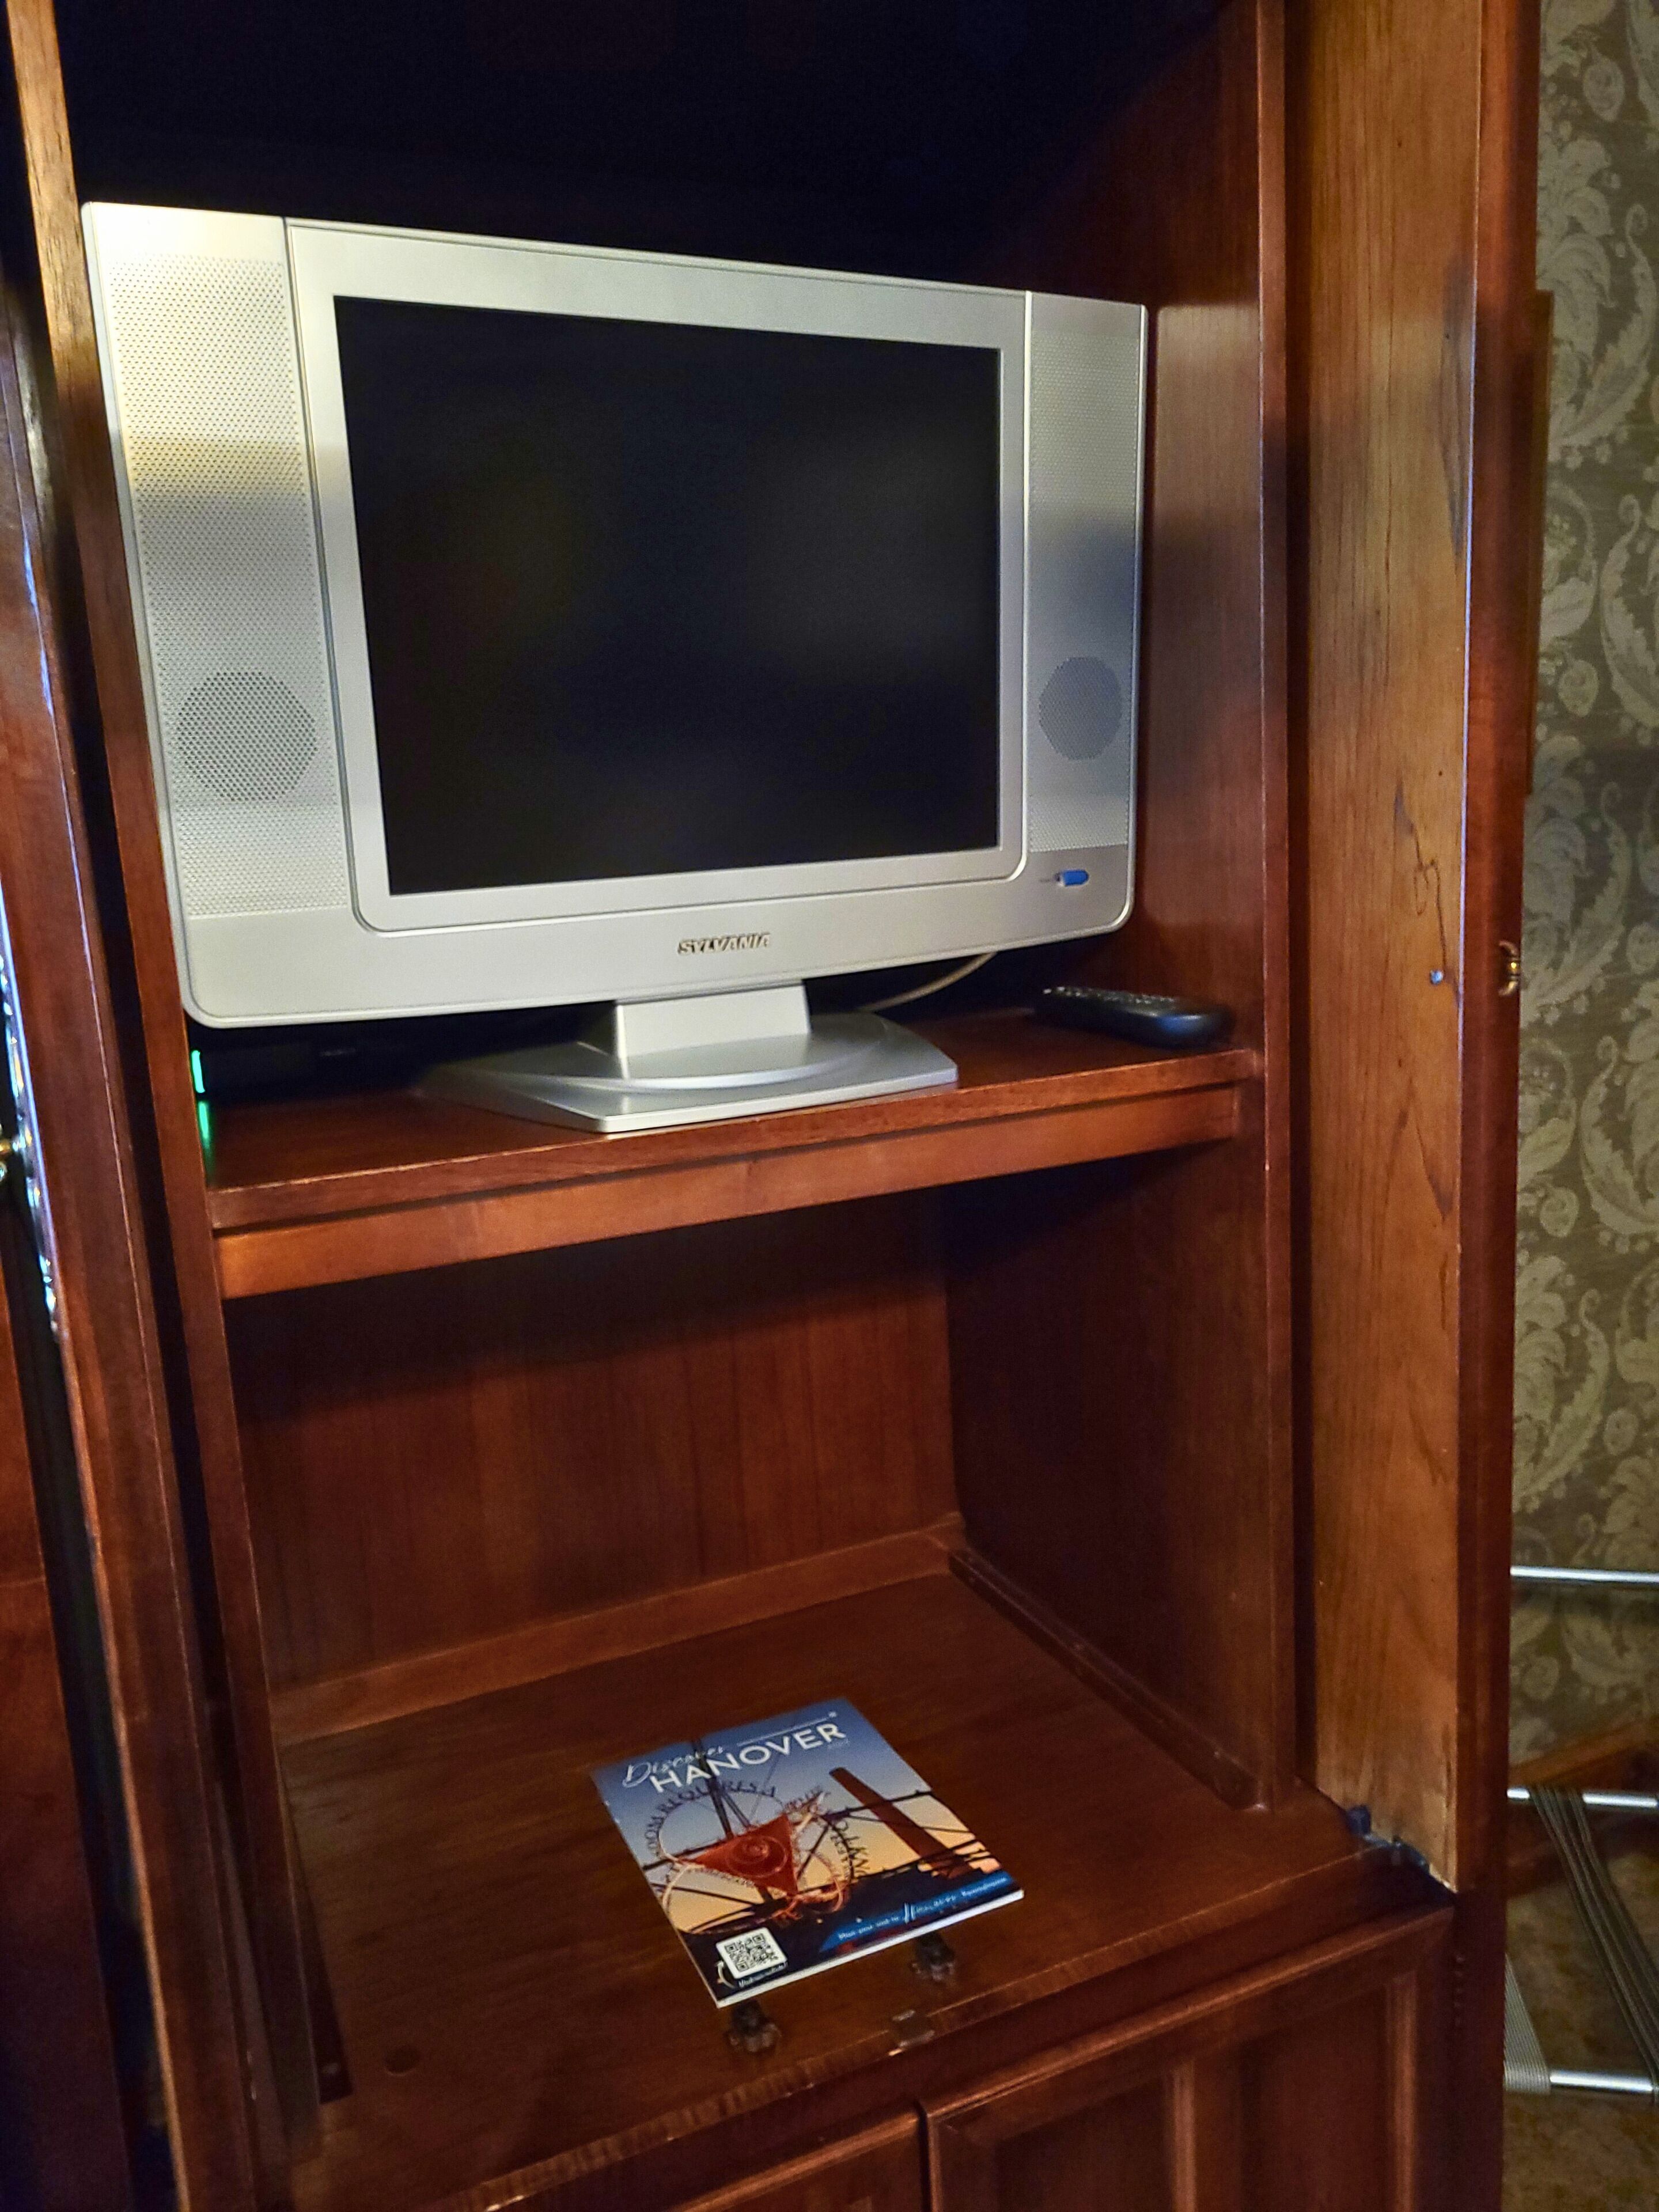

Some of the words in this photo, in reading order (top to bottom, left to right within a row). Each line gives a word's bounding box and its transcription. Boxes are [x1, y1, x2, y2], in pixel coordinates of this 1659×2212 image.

[678, 931, 770, 955] SYLVANIA
[622, 1745, 724, 1788] Discover
[649, 1724, 847, 1793] HANOVER
